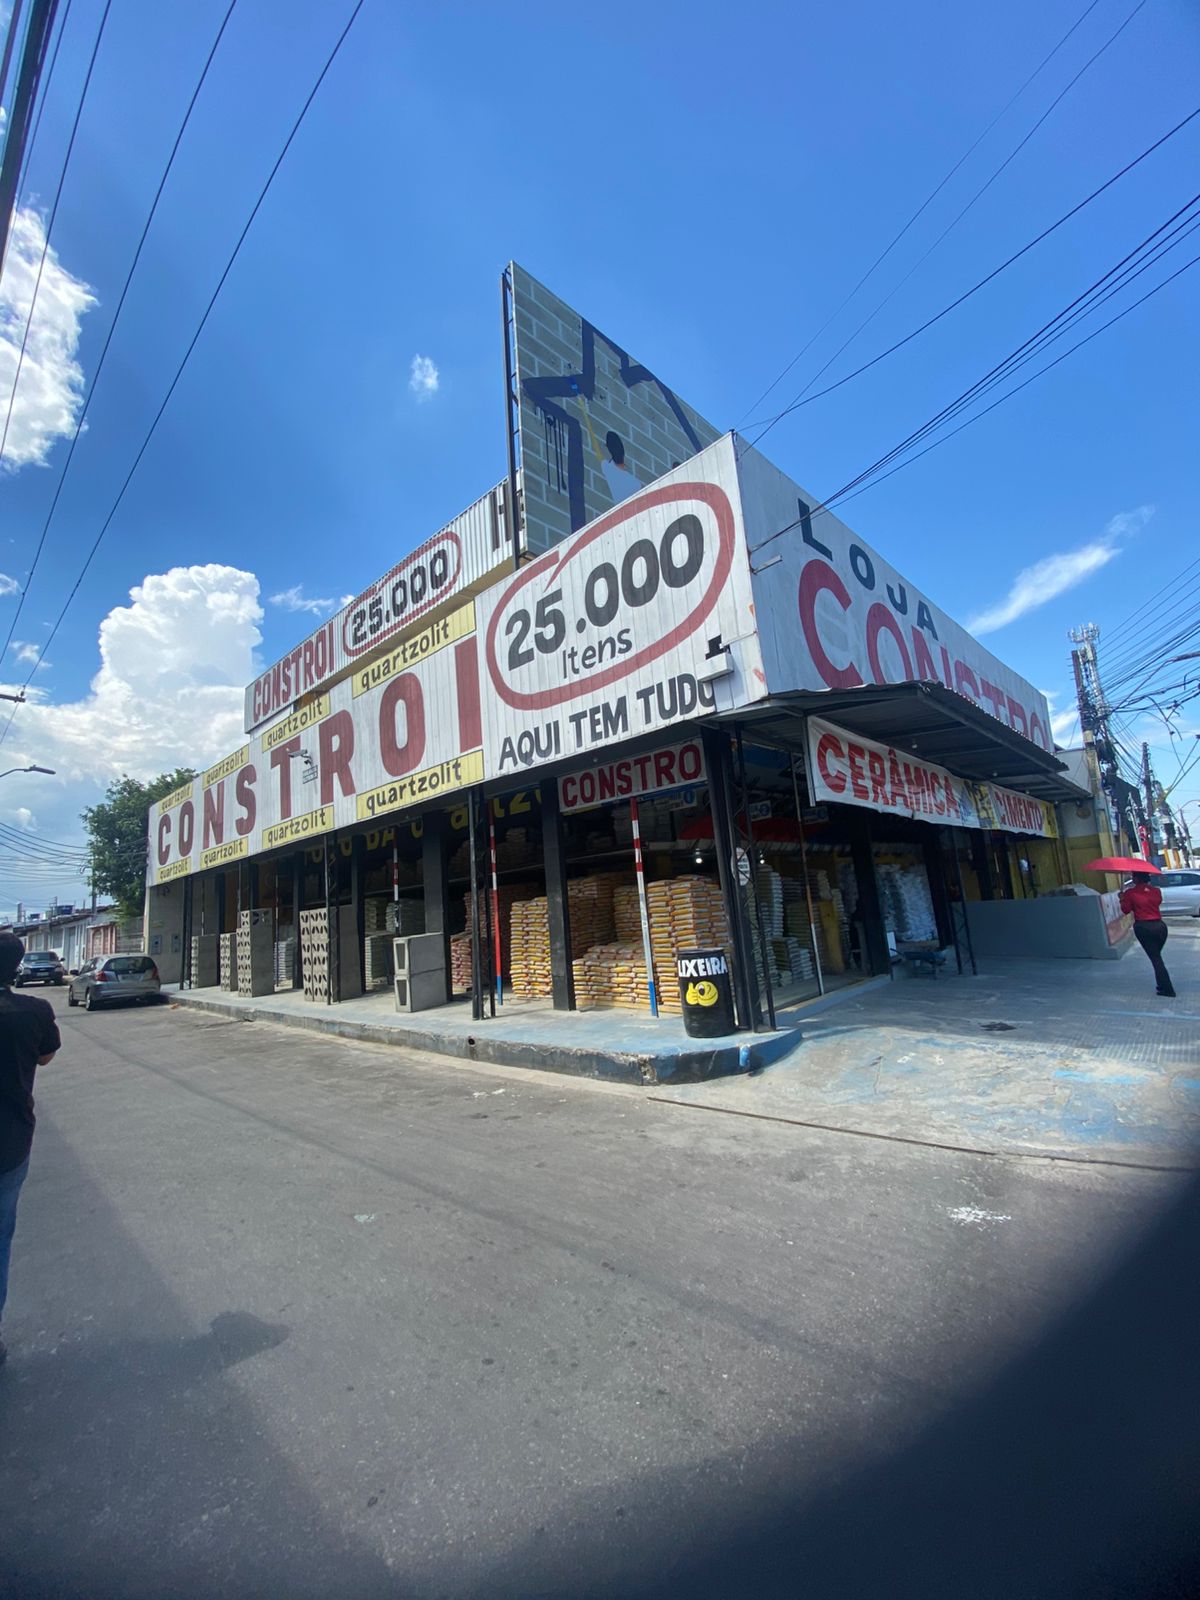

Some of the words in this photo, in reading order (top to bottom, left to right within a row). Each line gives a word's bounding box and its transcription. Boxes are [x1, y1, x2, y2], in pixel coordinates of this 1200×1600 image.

[352, 549, 447, 646] 25.000
[505, 514, 704, 671] 25.000
[798, 498, 938, 641] LOJA
[253, 622, 335, 723] CONSTROI
[362, 620, 449, 690] quartzolit
[158, 636, 482, 866] CONSTROI
[267, 697, 322, 746] quartzolit
[499, 721, 560, 770] AQUI
[569, 696, 628, 748] TEM
[162, 786, 190, 810] quartzolit
[206, 749, 244, 783] quartzolit
[366, 759, 461, 816] quartzolit
[562, 744, 702, 808] CONSTRO
[817, 733, 961, 819] CERÂMICA
[204, 840, 243, 867] quartzolit
[268, 808, 325, 847] quartzolit
[160, 858, 188, 879] quartzolit
